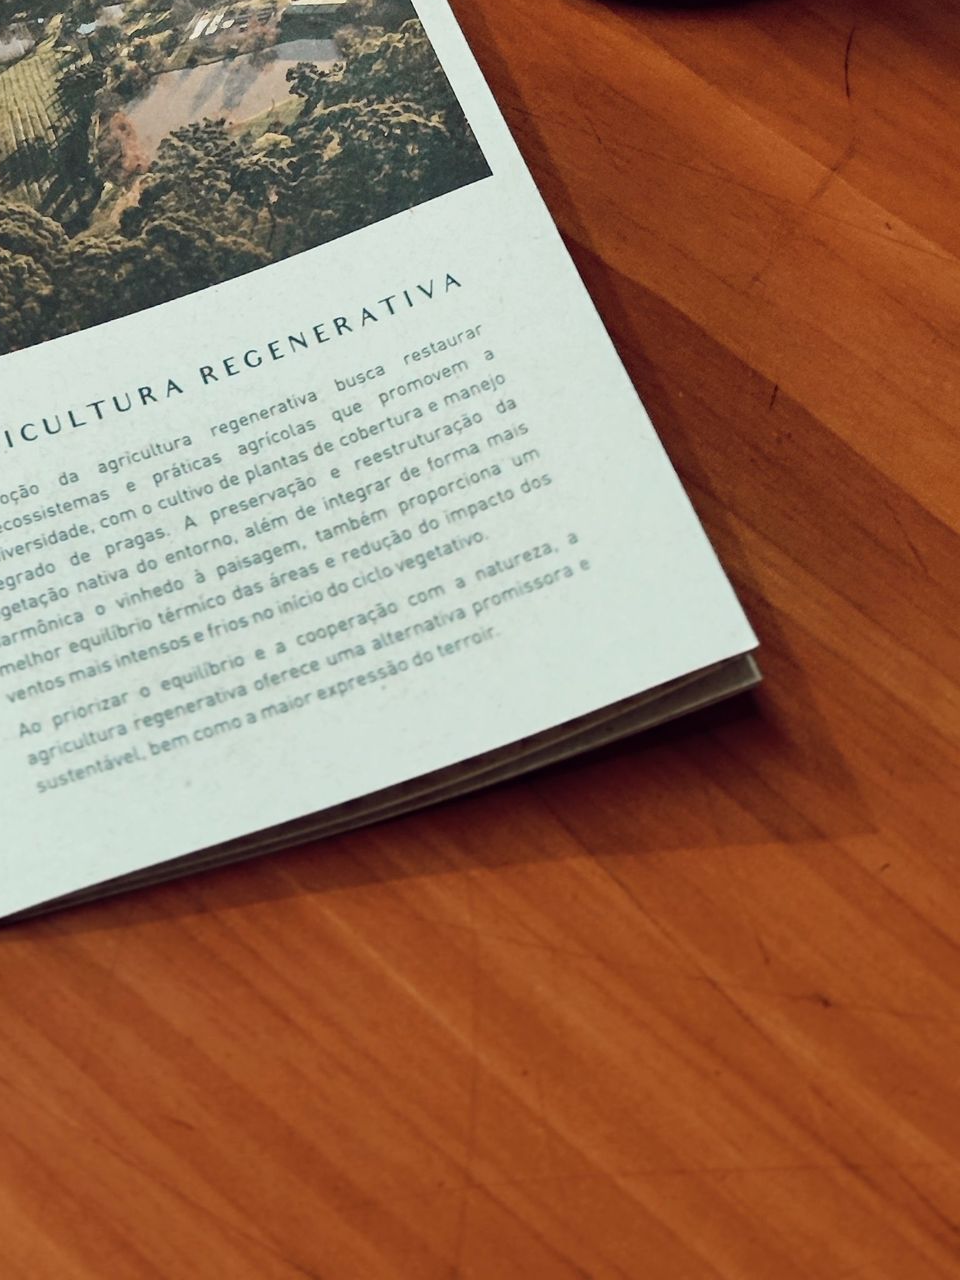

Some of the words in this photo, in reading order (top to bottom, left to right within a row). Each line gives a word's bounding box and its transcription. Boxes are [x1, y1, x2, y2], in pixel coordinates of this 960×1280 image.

[57, 470, 80, 486] da
[97, 434, 193, 474] agricultura
[209, 390, 318, 437] regenerativa
[332, 364, 386, 392] busca
[402, 323, 482, 365] restaurar
[198, 272, 462, 385] REGENERATIVA
[68, 550, 91, 567] de
[103, 526, 170, 559] pragas.
[183, 514, 198, 531] A
[208, 475, 317, 525] preservação
[329, 466, 341, 479] e
[353, 411, 483, 471] reestruturação
[494, 397, 517, 414] da
[98, 507, 137, 529] com
[140, 503, 153, 515] o
[156, 482, 214, 510] cultivo
[217, 473, 240, 490] de
[243, 449, 309, 485] plantas
[312, 440, 335, 457] de
[338, 406, 424, 447] cobertura
[427, 400, 439, 412] e
[442, 373, 506, 406] manejo
[125, 480, 137, 493] e
[151, 451, 223, 488] práticas
[236, 418, 317, 456] agrícolas
[330, 401, 363, 423] que
[377, 359, 469, 408] promovem
[483, 348, 495, 361] a
